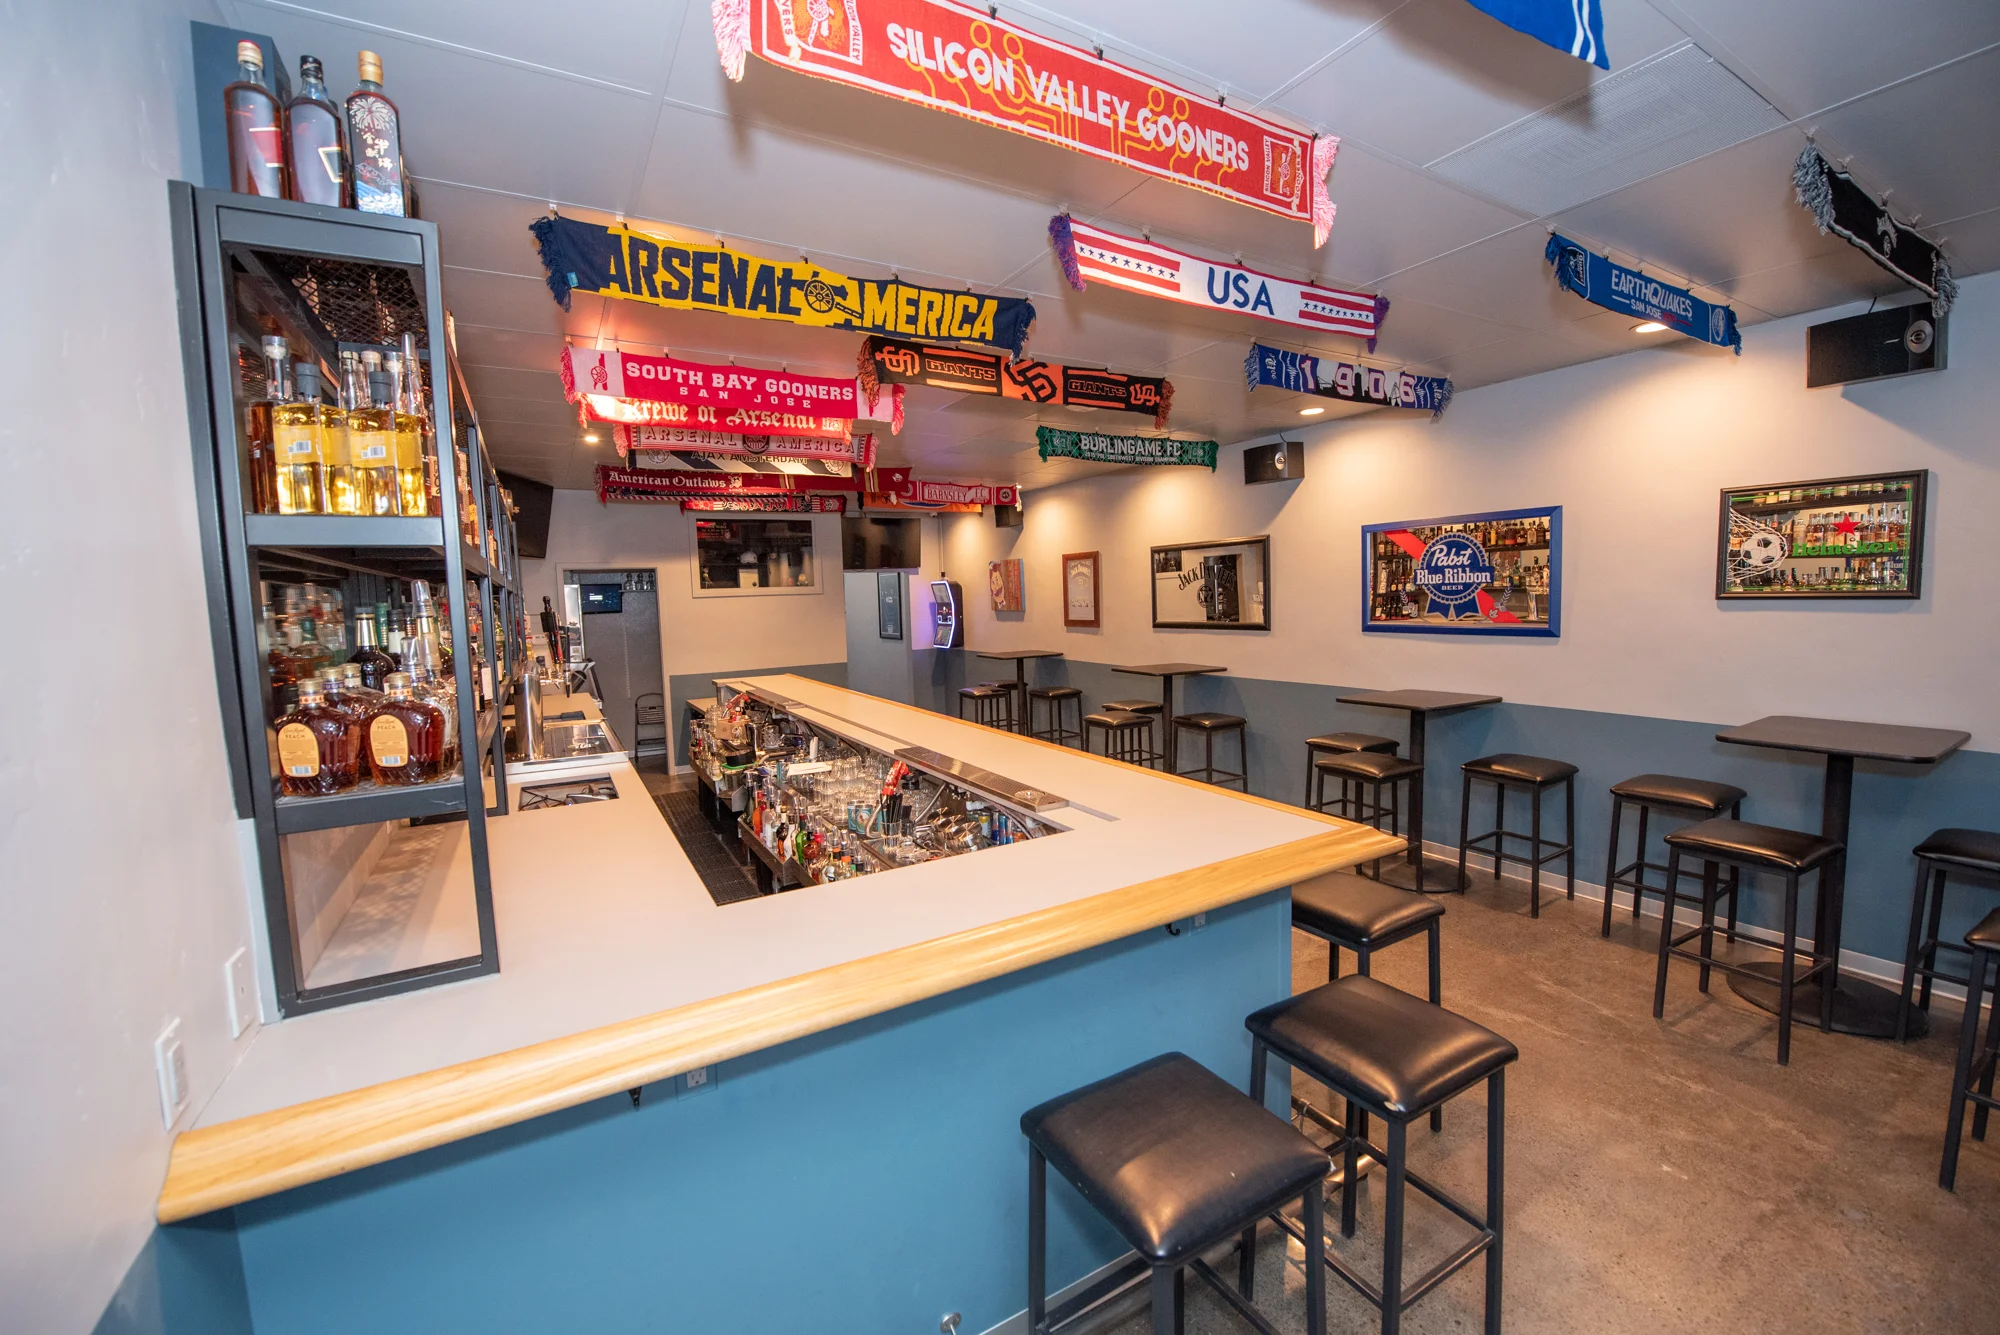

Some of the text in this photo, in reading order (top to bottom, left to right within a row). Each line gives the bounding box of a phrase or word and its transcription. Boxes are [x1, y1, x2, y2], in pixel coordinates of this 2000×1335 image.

[852, 25, 861, 61] VALLEY
[886, 22, 1250, 172] SILICON VALLEY GOONERS
[603, 234, 801, 317] ARSENAL
[1207, 266, 1275, 316] USA
[1611, 268, 1693, 318] EARTHQUAKES
[1630, 299, 1645, 312] SAN
[1645, 304, 1662, 319] JOSE
[625, 362, 853, 400] SOUTH BAY GOONERS
[925, 359, 997, 381] GIANTS
[679, 386, 811, 408] SAN JOSE
[1067, 379, 1127, 397] GIANTS
[624, 400, 688, 422] Krewe
[726, 406, 817, 429] Arsenal
[643, 426, 737, 446] ARSENAL
[775, 434, 855, 453] AMERICA
[1080, 435, 1162, 455] BURLINGAME
[1167, 441, 1181, 456] FC
[609, 471, 726, 488] American Outlaws
[927, 488, 967, 502] BARNSLEY
[1430, 544, 1473, 567] Pabst
[1791, 540, 1898, 557] Heineken
[1178, 566, 1200, 591] JACK
[1415, 567, 1492, 585] Blue Ribbon
